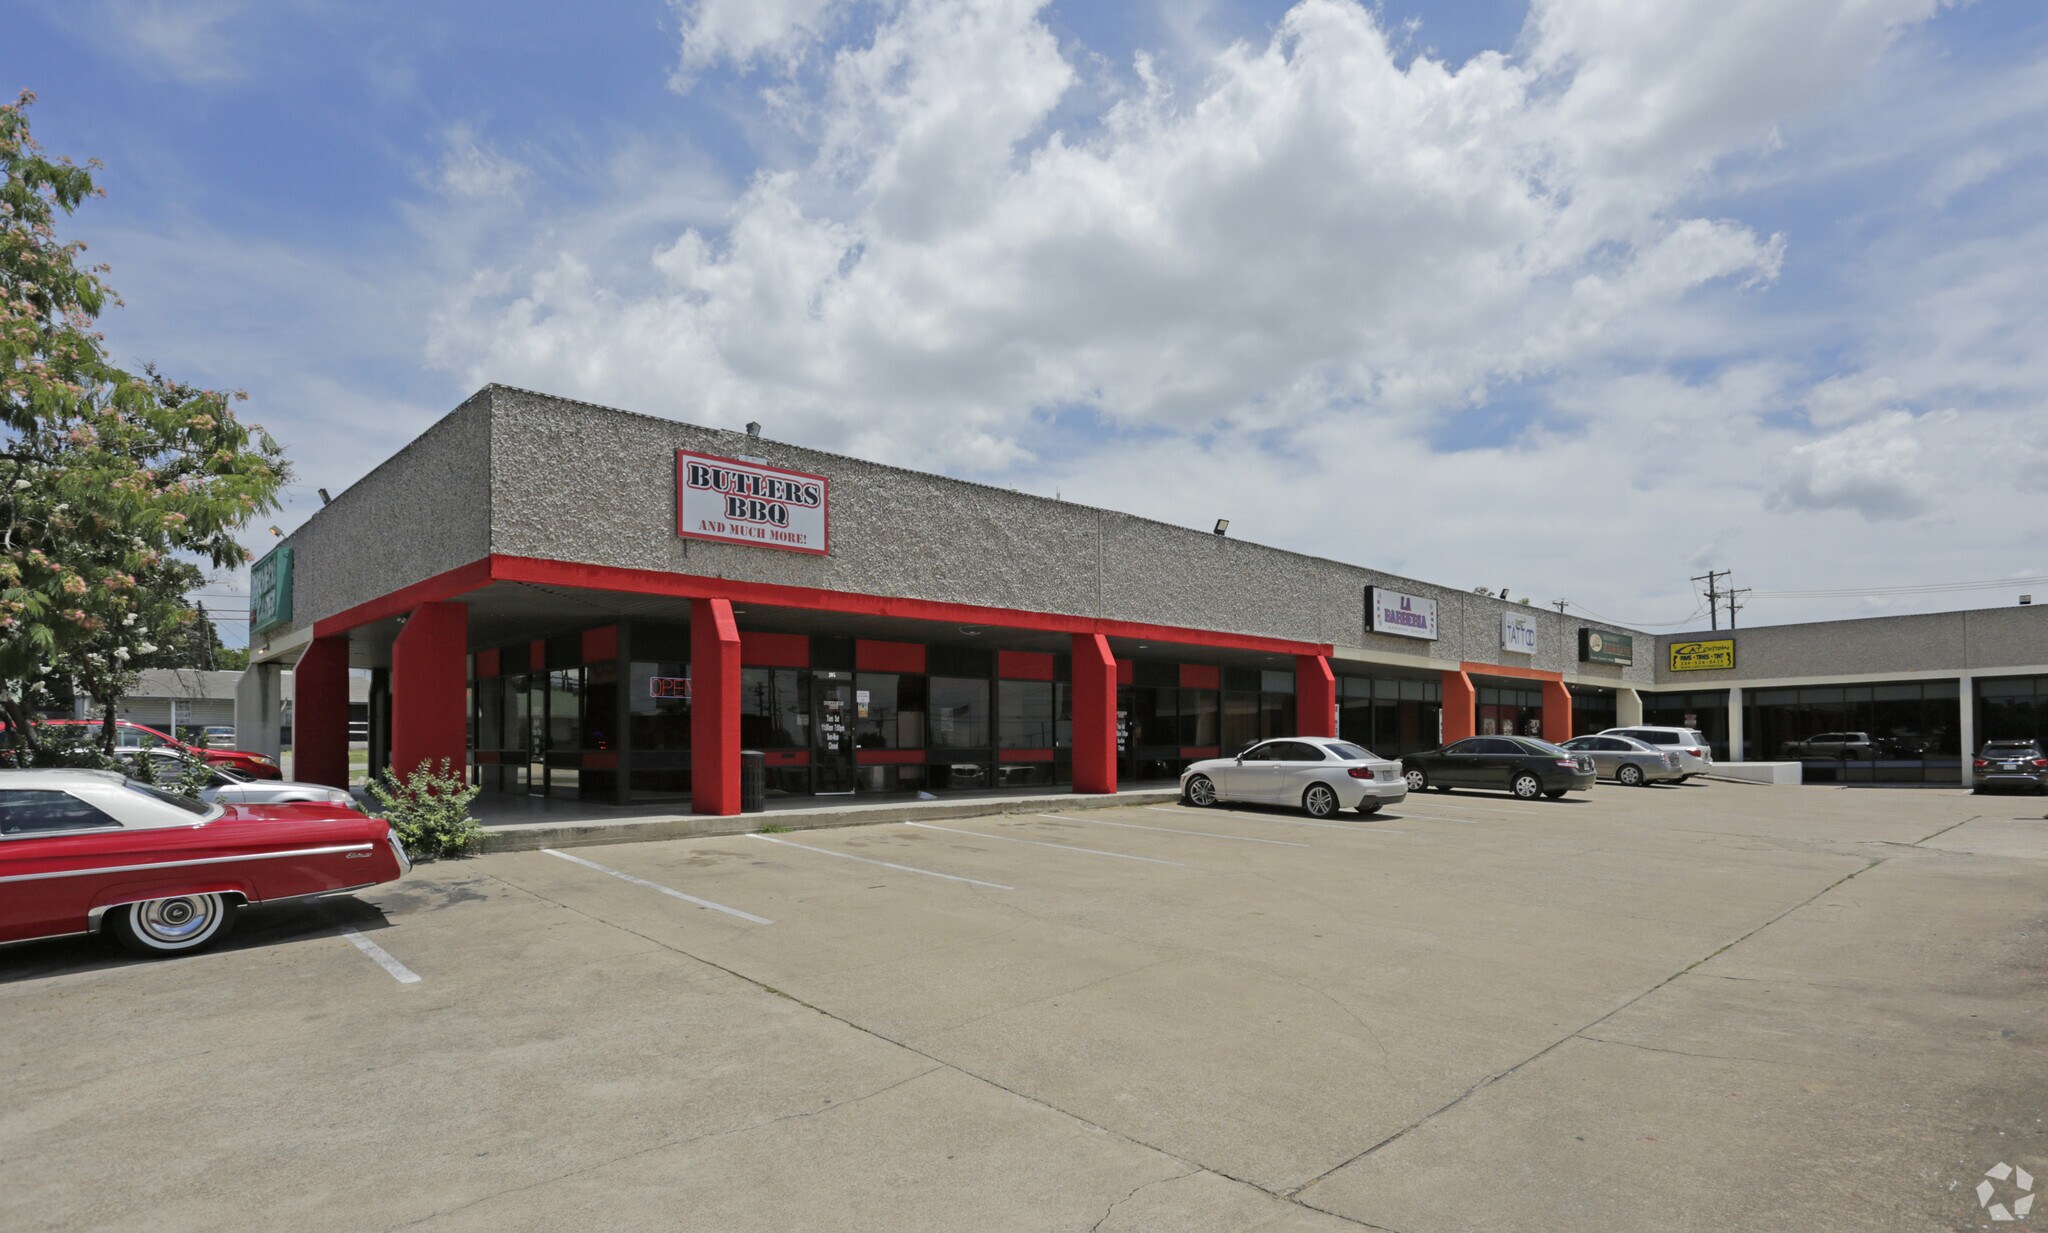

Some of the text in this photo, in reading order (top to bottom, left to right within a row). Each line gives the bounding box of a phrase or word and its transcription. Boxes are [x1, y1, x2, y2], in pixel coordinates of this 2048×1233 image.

[688, 463, 820, 506] BUTLERS
[726, 495, 787, 526] BBQ
[699, 519, 808, 545] AND MUCH MORE!
[1400, 596, 1412, 612] LA
[1384, 608, 1428, 630] BARBERIA
[1507, 624, 1535, 647] TATTOO
